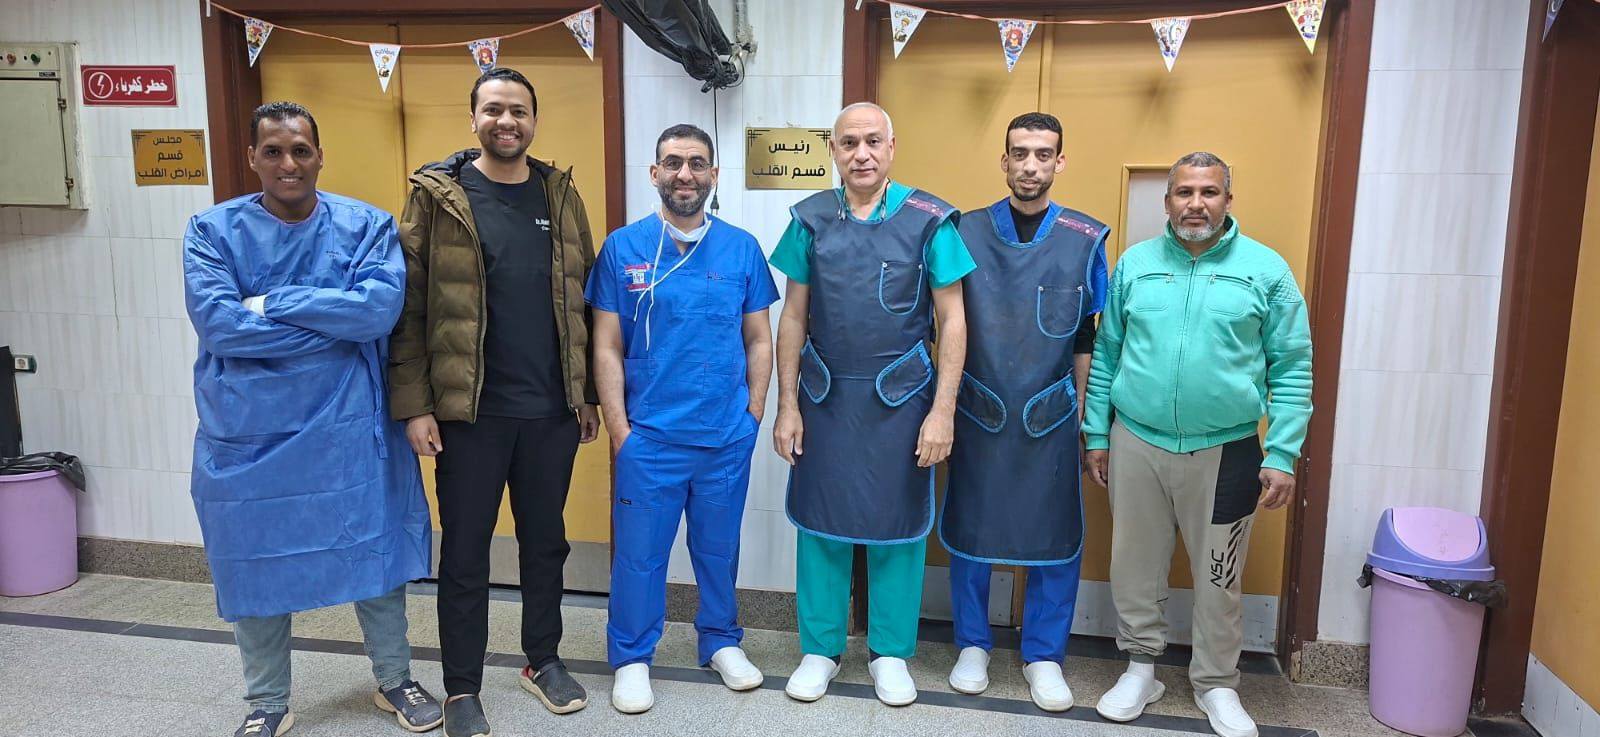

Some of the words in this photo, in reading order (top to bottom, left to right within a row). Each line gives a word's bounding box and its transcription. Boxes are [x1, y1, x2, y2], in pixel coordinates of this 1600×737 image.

[115, 76, 142, 96] كهرباء
[144, 79, 168, 94] خطر
[768, 140, 810, 154] رئيس
[158, 150, 183, 163] قسم
[138, 168, 166, 179] القلب
[752, 165, 787, 178] القلب
[792, 165, 826, 179] قسم
[1210, 549, 1225, 587] NSC
